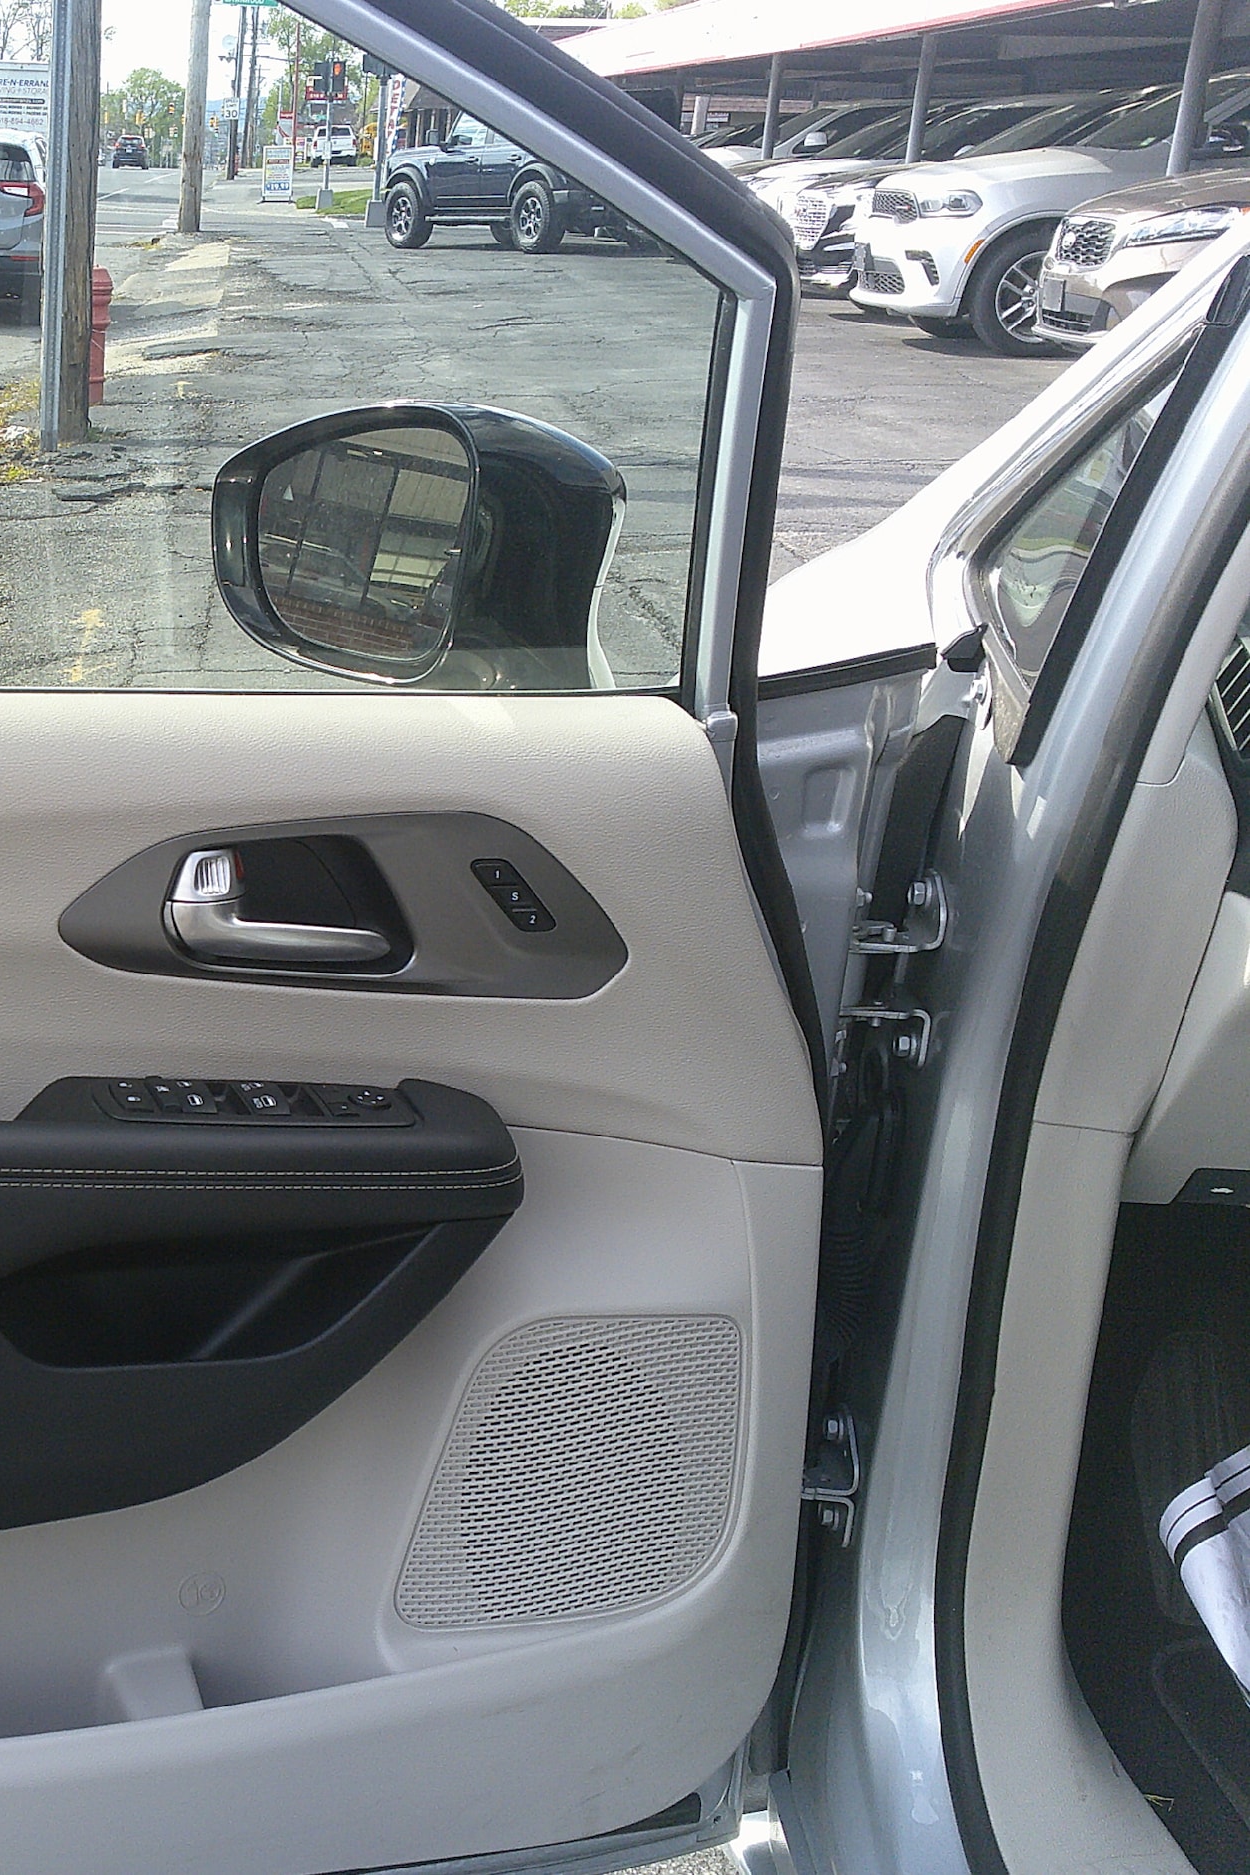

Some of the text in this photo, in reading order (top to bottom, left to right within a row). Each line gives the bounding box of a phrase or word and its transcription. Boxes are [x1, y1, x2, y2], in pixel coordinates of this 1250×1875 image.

[23, 87, 49, 96] STORA
[225, 109, 238, 118] 30
[494, 870, 500, 879] 1
[511, 891, 519, 901] S
[529, 915, 536, 924] 2
